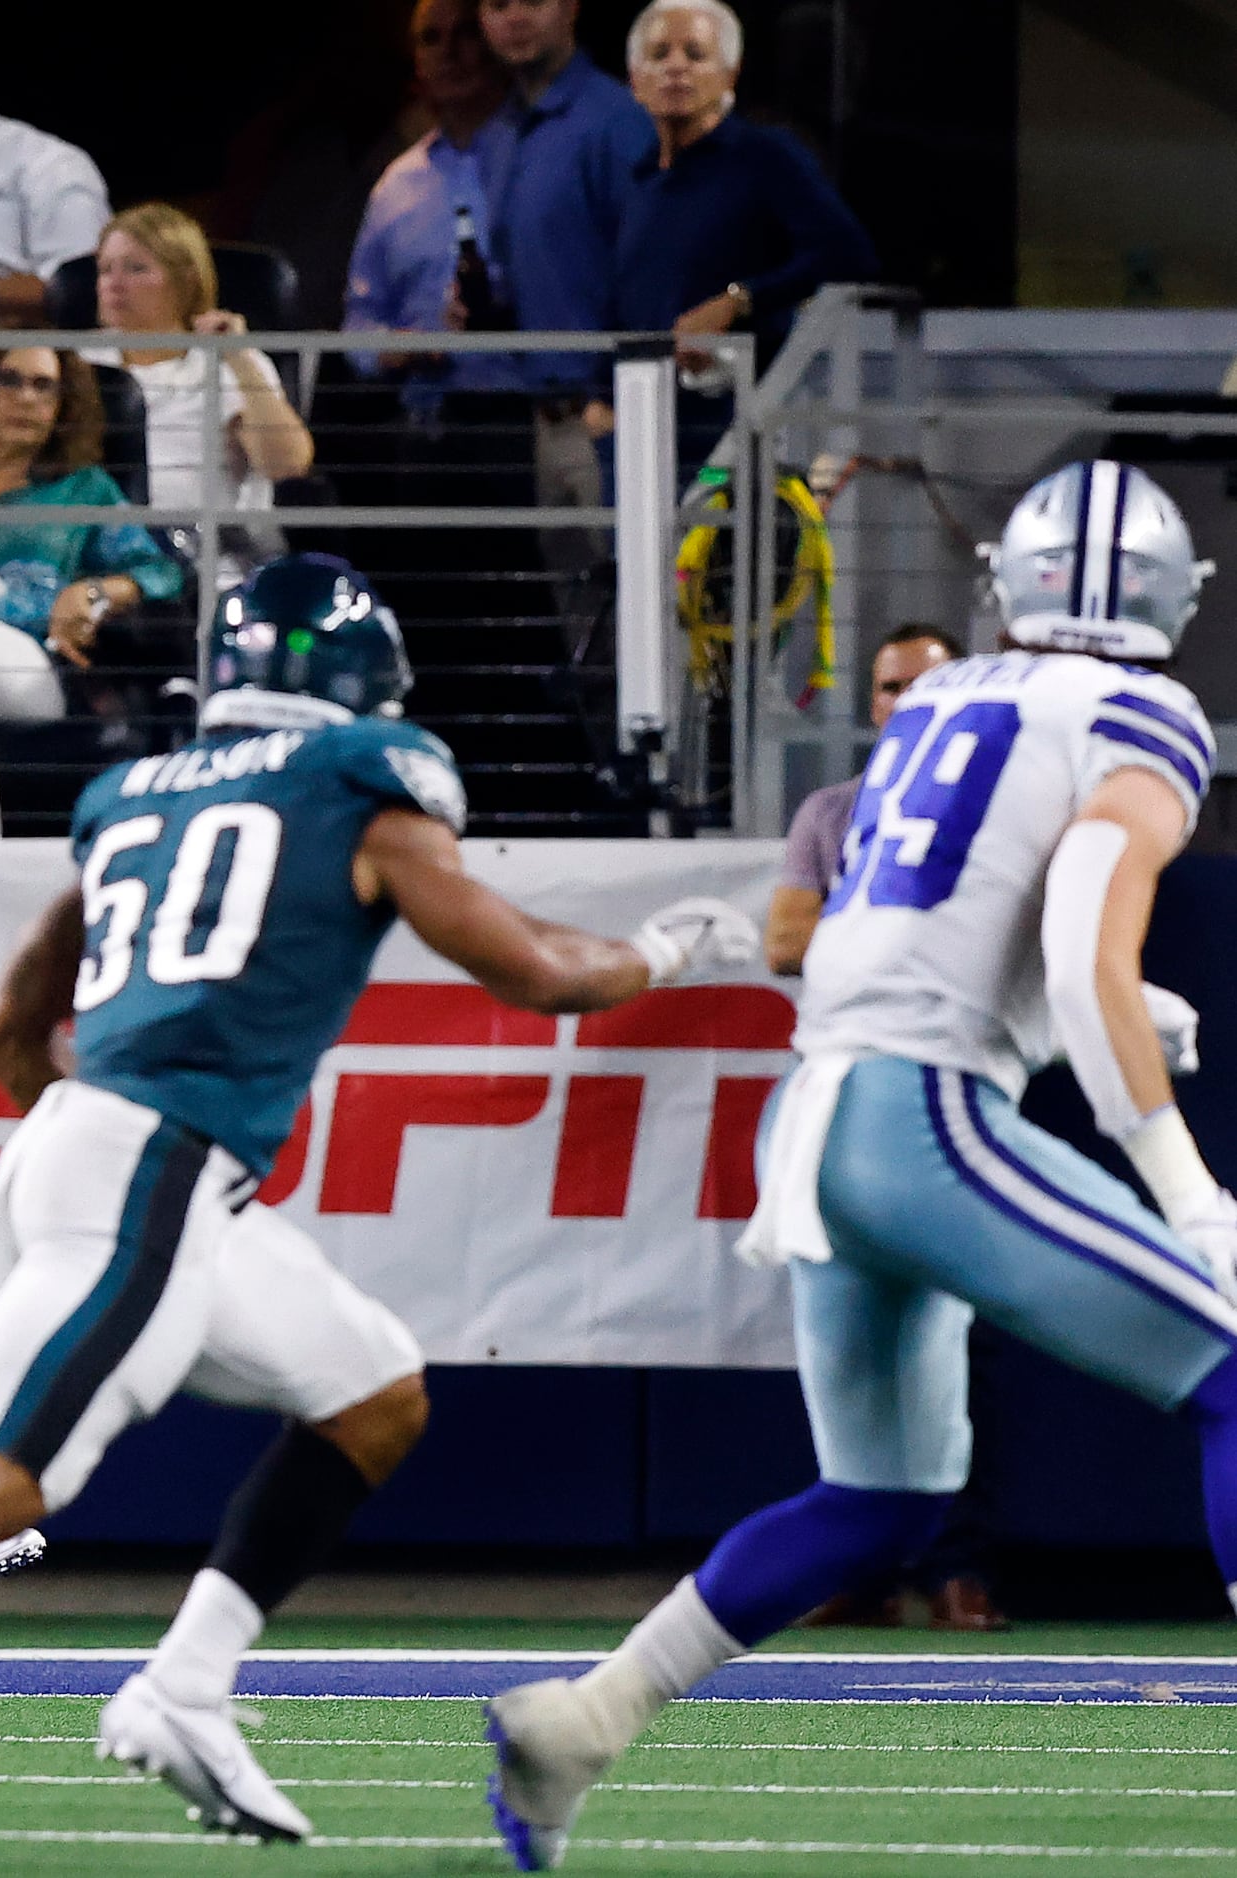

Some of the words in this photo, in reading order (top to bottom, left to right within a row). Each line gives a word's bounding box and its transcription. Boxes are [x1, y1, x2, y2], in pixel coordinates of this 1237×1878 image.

[120, 729, 305, 797] WILSON
[821, 702, 1022, 918] 89
[72, 802, 283, 1011] 50
